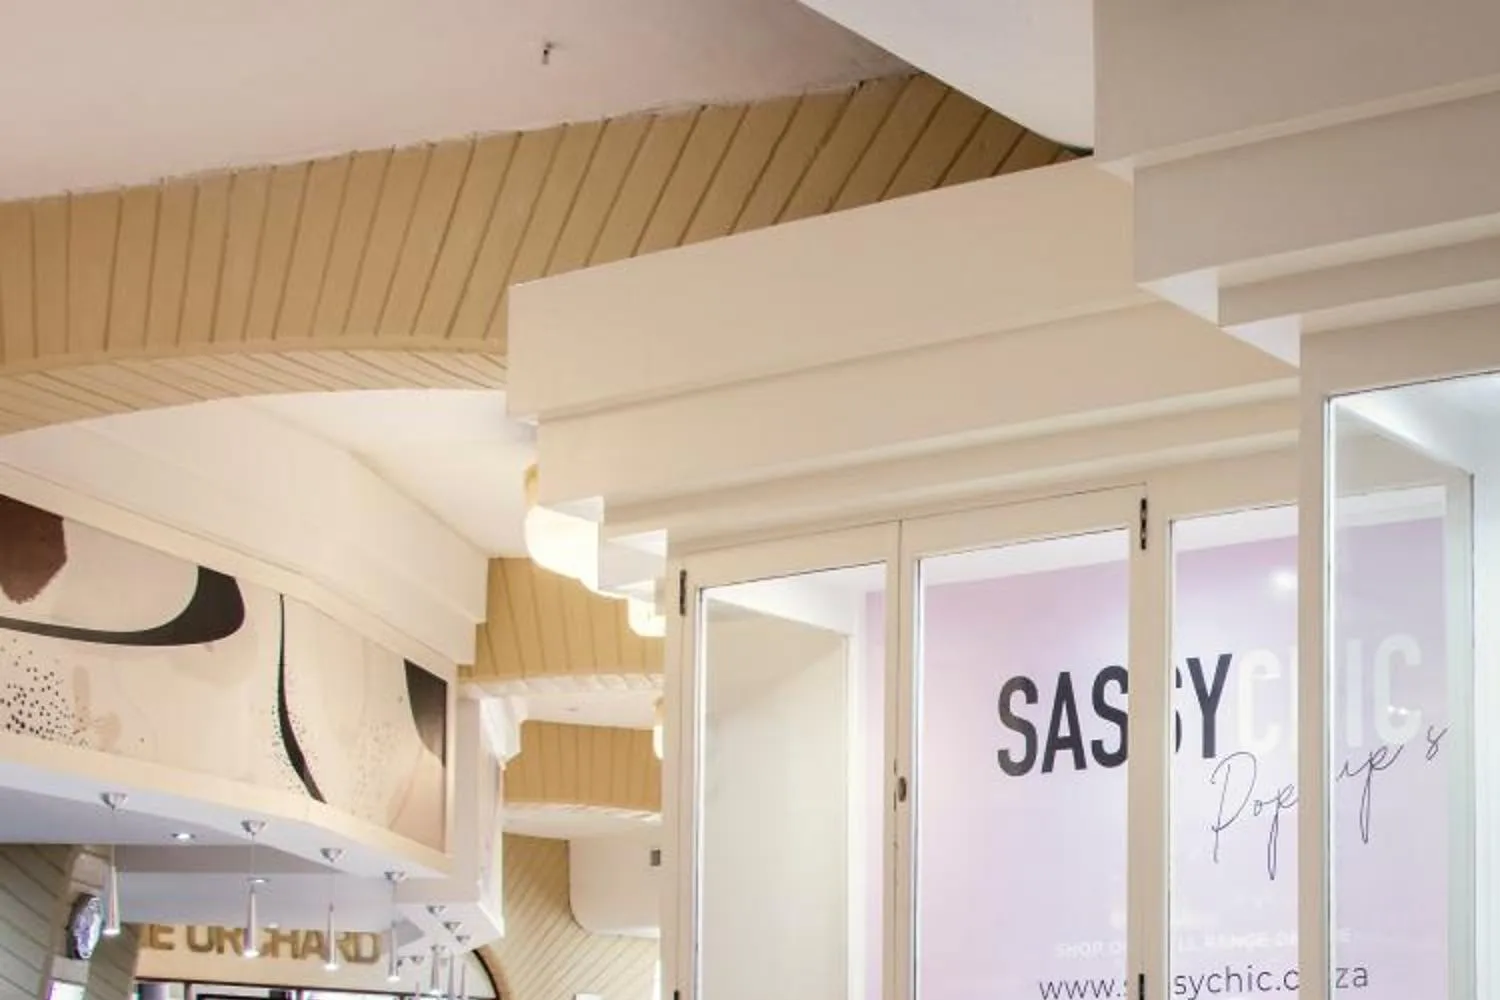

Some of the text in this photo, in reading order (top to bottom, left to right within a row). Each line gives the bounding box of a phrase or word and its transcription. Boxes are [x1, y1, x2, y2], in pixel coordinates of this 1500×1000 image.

[997, 631, 1422, 777] SASYCIC
[1210, 751, 1298, 880] Pop
[1039, 964, 1369, 1000] www.sychic.cza
